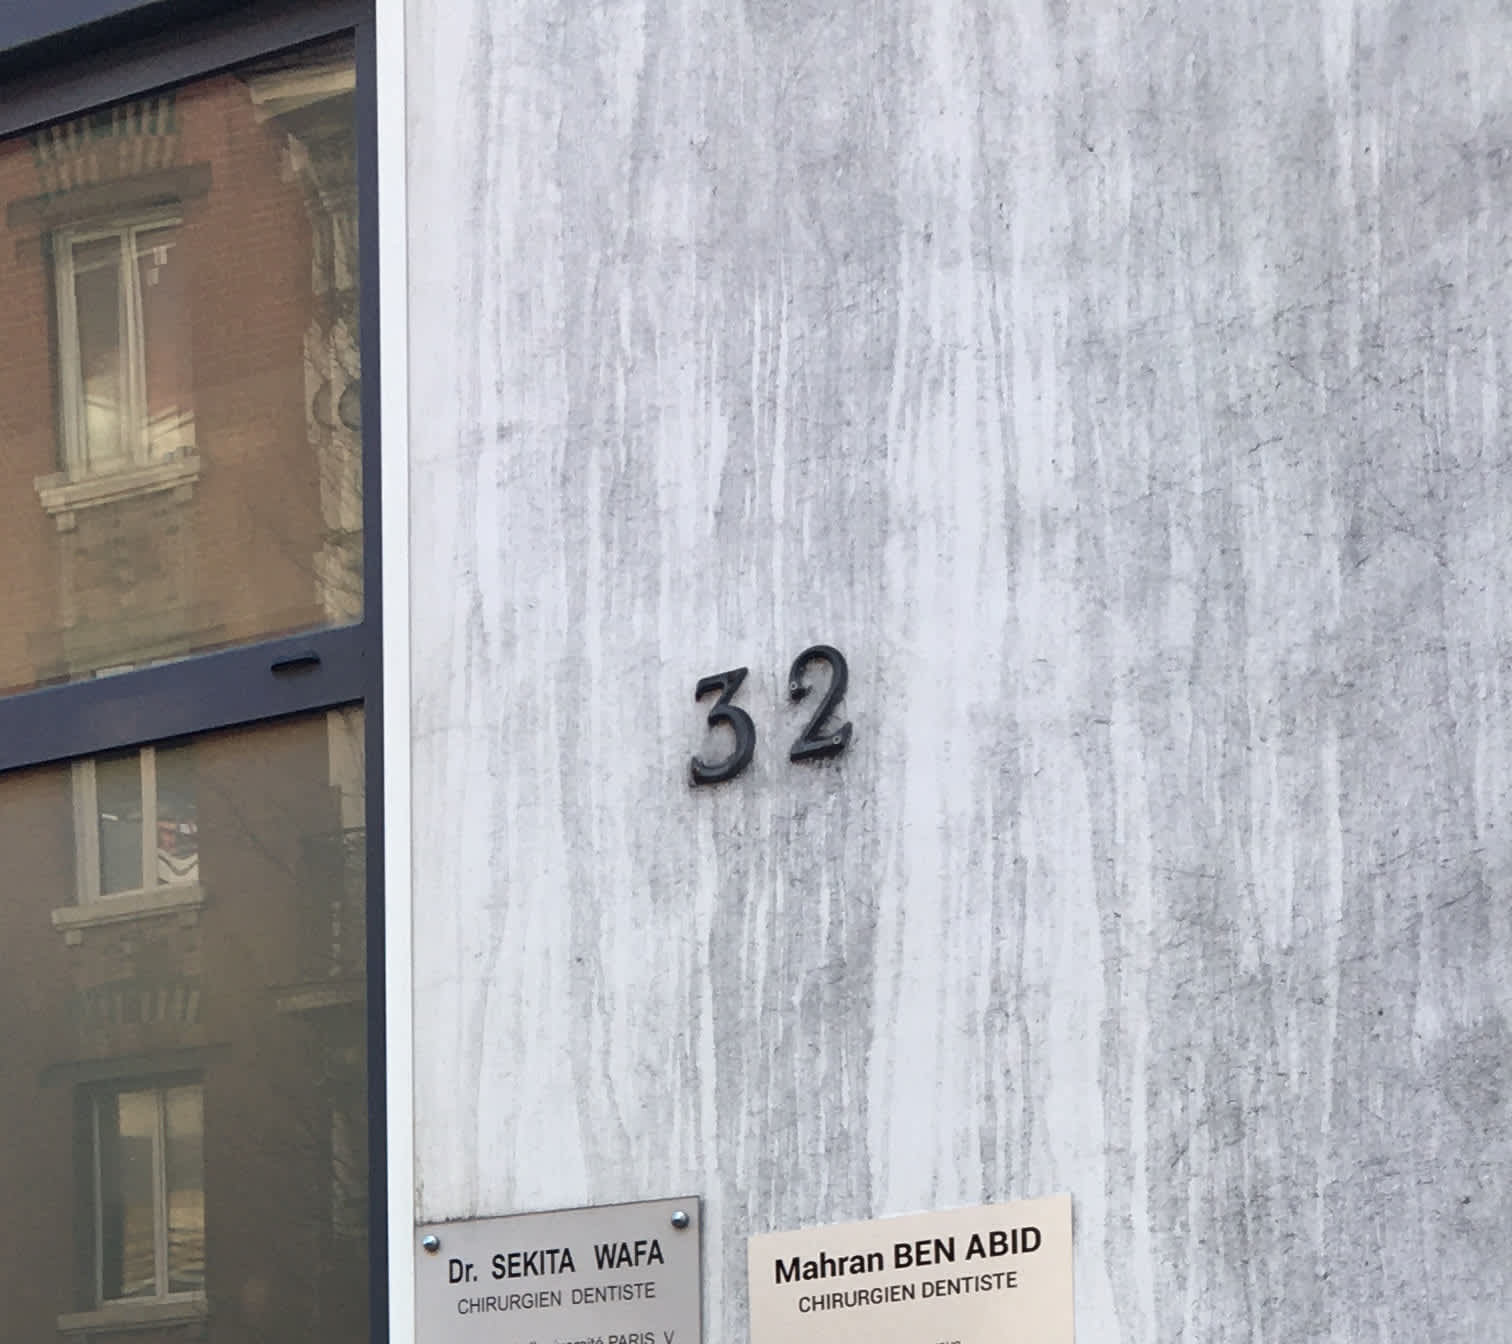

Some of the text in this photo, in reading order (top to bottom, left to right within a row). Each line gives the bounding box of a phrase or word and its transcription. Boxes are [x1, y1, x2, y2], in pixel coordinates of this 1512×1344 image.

[690, 644, 853, 785] 32
[449, 1240, 664, 1284] Dr. SEKITA WAFA
[775, 1226, 1041, 1284] Mahran BEN ABID
[457, 1282, 656, 1315] CHIRURGIEN DENTISTE
[798, 1271, 1018, 1313] CHIRURGIEN DENTISTE
[664, 1330, 675, 1344] V
